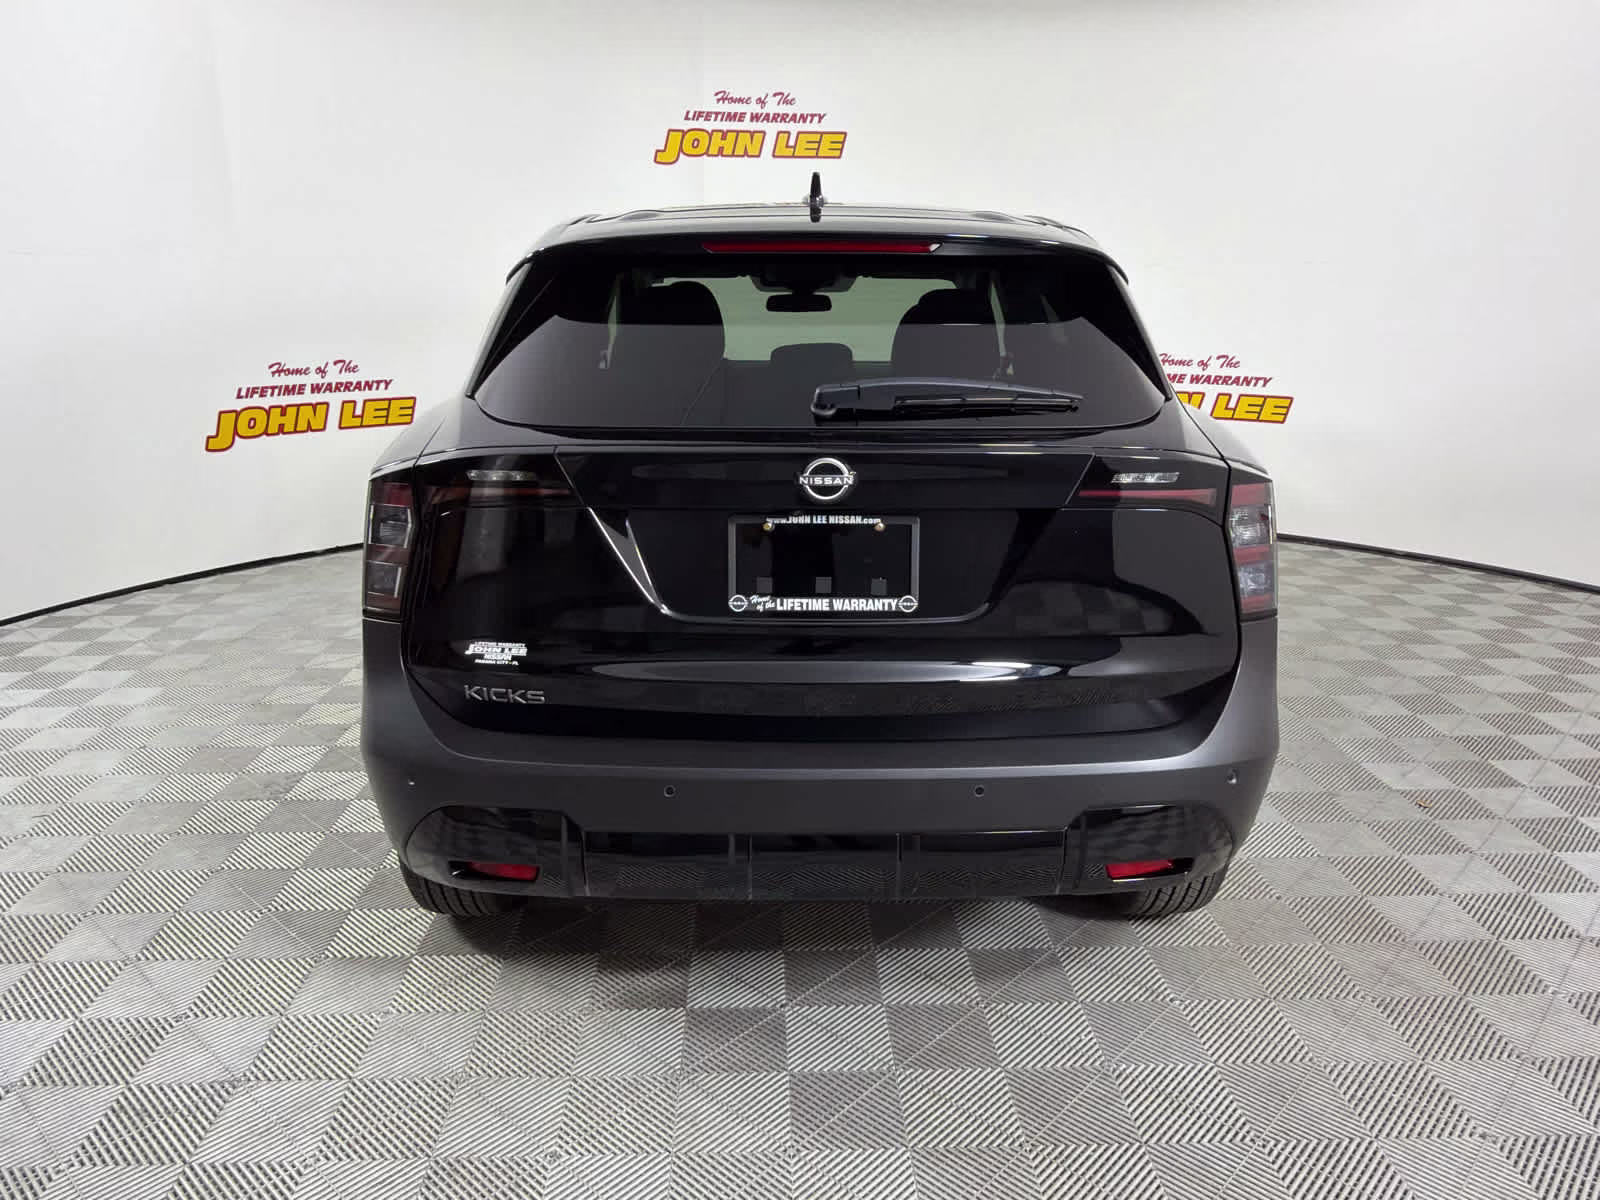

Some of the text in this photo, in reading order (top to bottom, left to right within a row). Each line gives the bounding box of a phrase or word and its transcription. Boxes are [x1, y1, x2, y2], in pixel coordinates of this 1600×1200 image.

[714, 90, 796, 109] Home of The
[684, 110, 826, 124] LIFETIME WARRANTY
[653, 127, 847, 165] JOHN LEE
[268, 359, 359, 379] Home of The
[1159, 353, 1241, 371] Home of The
[236, 379, 393, 399] LIFETIME WARRANTY
[1190, 374, 1272, 387] WARRANTY
[1210, 392, 1294, 424] LEE
[205, 397, 416, 452] JOHN LEE
[799, 476, 854, 485] NISSAN
[812, 515, 827, 524] LEE
[776, 598, 898, 611] LIFETIME WARRANTY
[465, 644, 527, 656] JOHN LEE
[464, 685, 545, 704] KICKS
